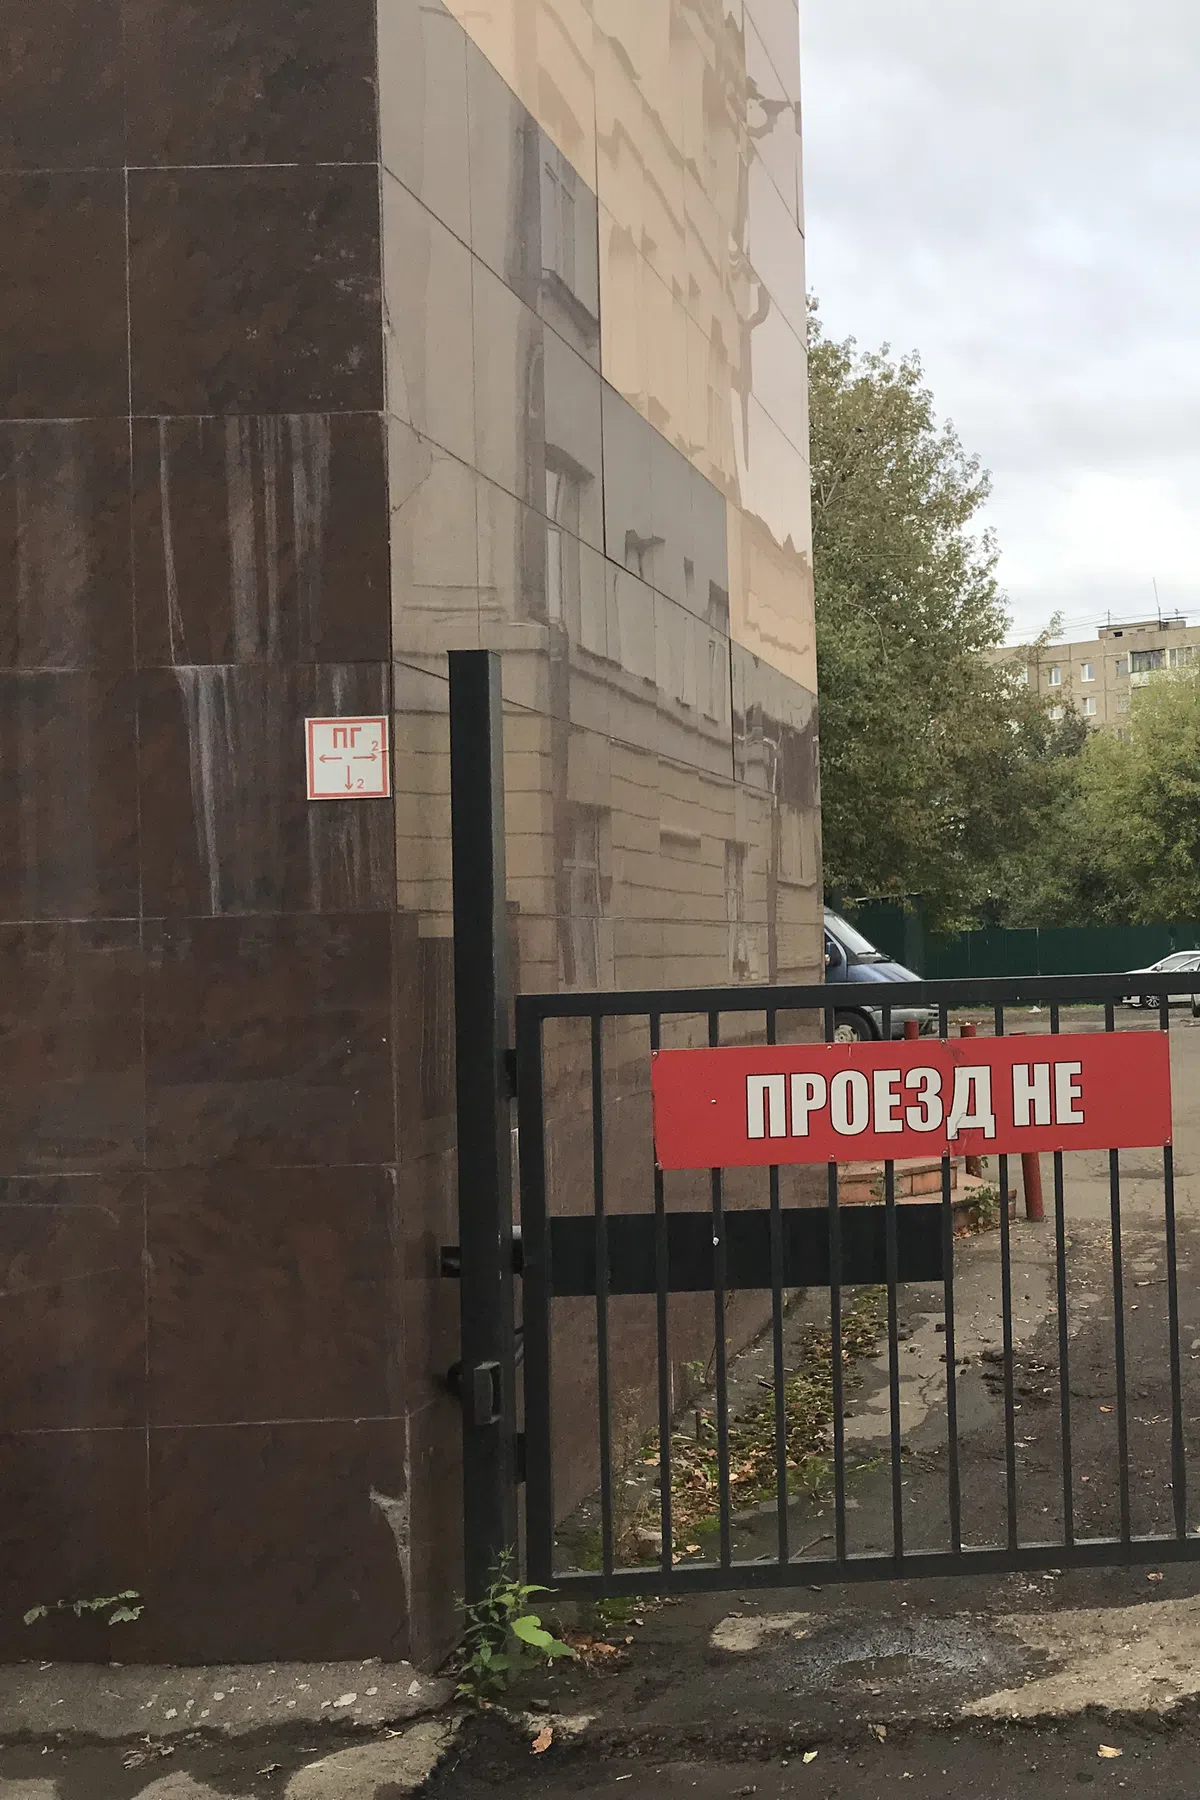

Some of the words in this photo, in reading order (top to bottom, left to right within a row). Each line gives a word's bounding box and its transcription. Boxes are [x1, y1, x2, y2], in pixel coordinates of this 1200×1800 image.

[333, 727, 361, 748] ПГ
[371, 740, 379, 751] 2
[357, 779, 364, 789] 2
[746, 1066, 996, 1139] ПРОЕЗД
[1012, 1061, 1084, 1127] НЕ
